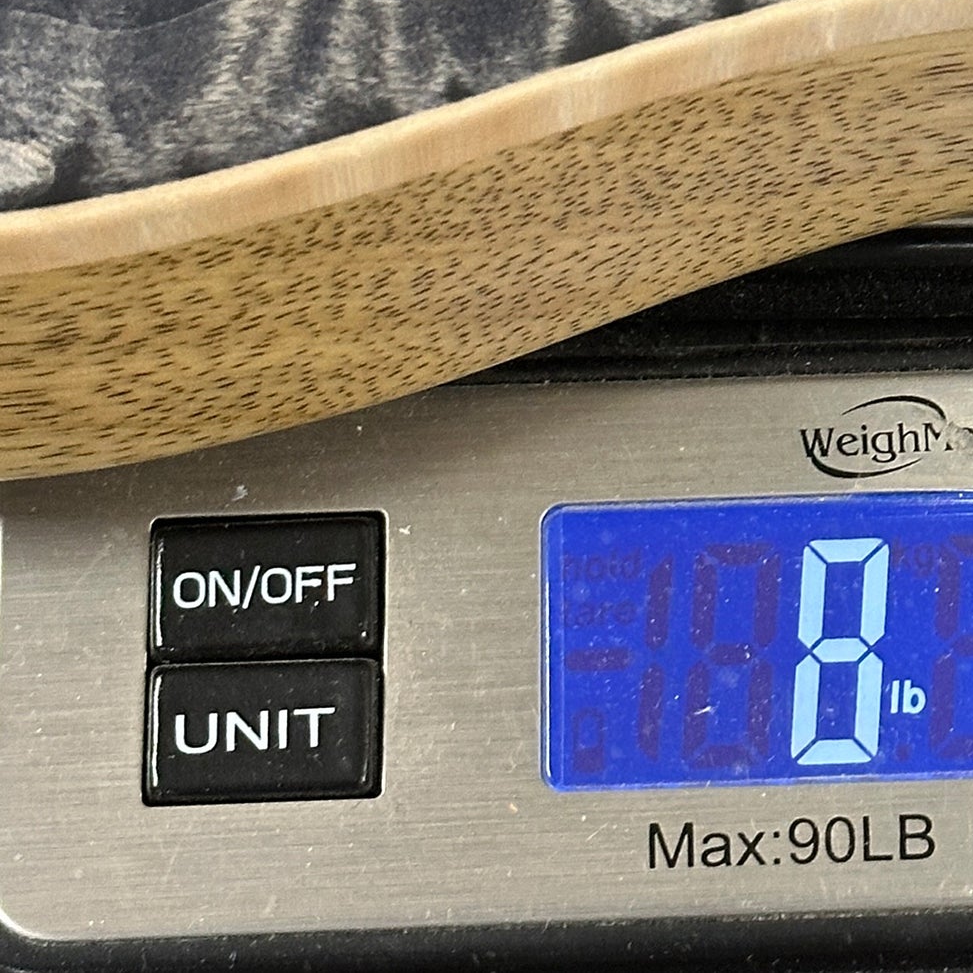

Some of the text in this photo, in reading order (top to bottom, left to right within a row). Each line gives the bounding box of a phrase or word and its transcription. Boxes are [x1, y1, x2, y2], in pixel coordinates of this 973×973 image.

[172, 563, 357, 610] ON/OFF
[790, 537, 890, 766] 8
[890, 679, 927, 715] lb
[174, 706, 336, 755] UNIT
[646, 813, 936, 870] Max:90LB
